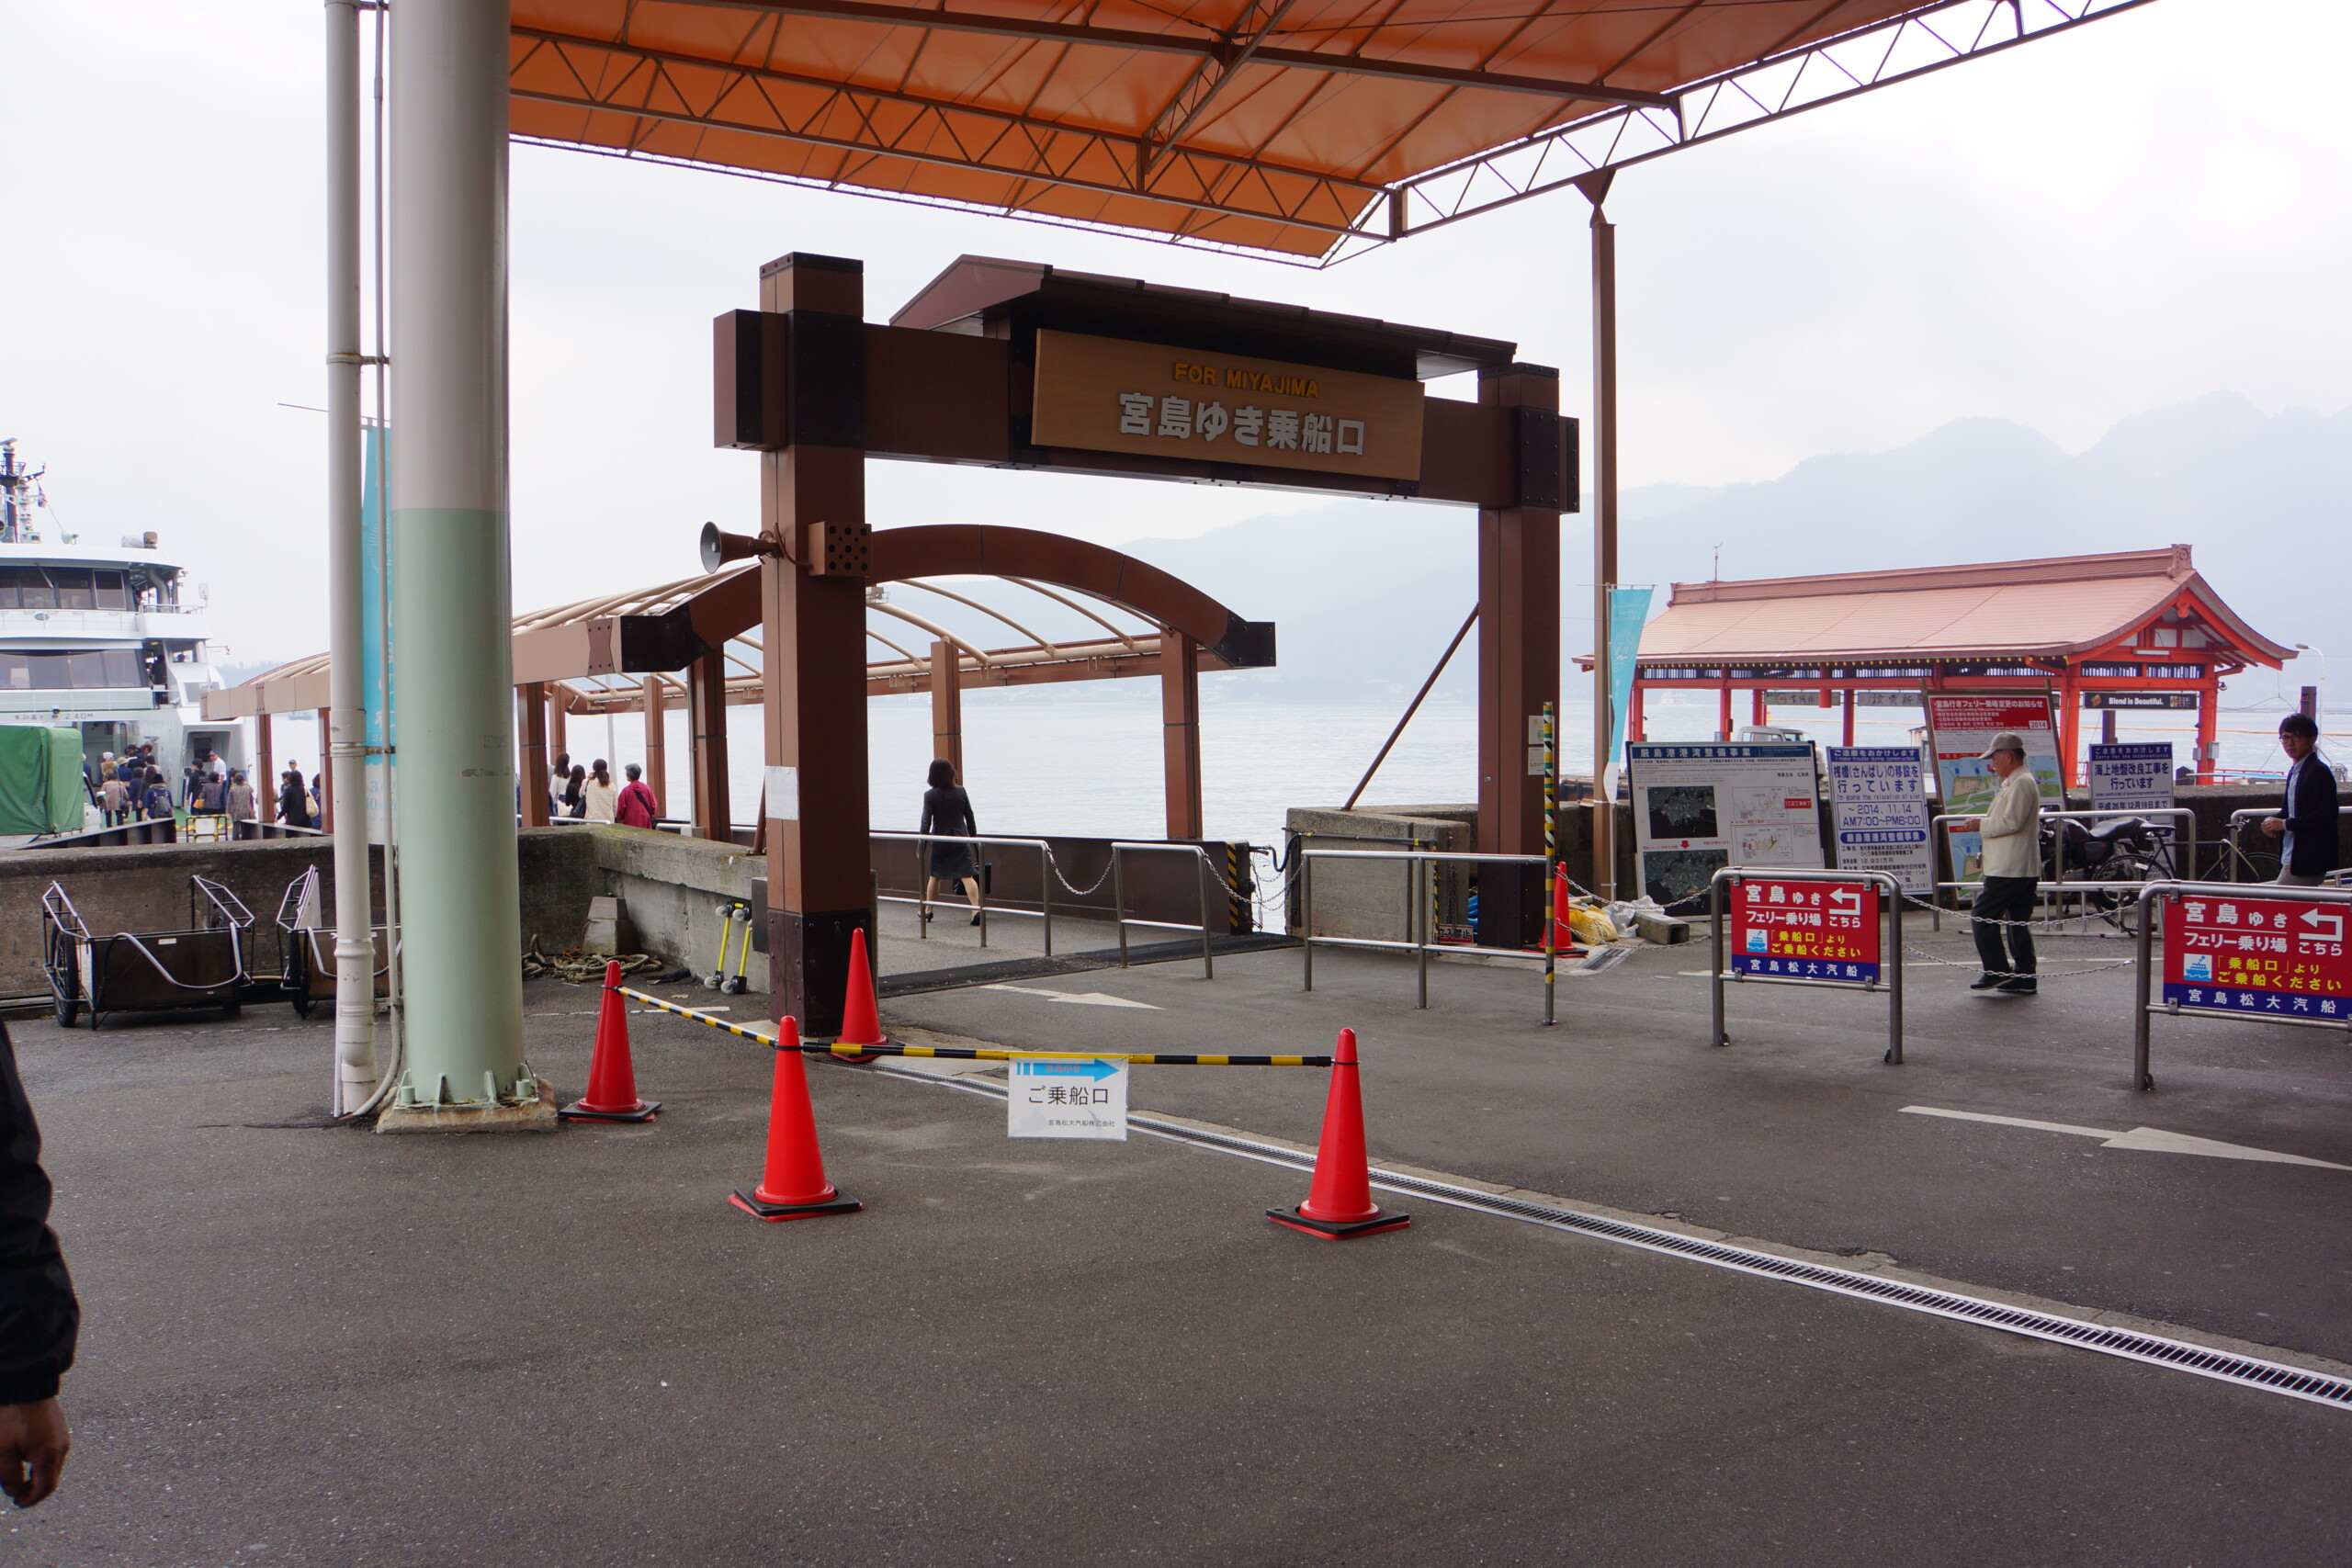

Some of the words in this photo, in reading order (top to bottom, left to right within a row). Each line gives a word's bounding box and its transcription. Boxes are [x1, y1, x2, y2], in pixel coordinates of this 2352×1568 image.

[1174, 363, 1217, 385] FOR
[1227, 369, 1320, 398] MIYAJIMA
[1118, 392, 1365, 455] 宮島ゆき乗船口
[2134, 697, 2164, 705] Beautiful.
[1640, 748, 1751, 758] 厳島港港湾整備事業
[1834, 764, 1918, 778] 桟橋(さんばし)の移設を
[2095, 762, 2169, 776] 海上地盤改良工事を
[1838, 779, 1917, 793] 行っています
[2110, 777, 2154, 790] 行っています
[1889, 804, 1912, 814] 11.14
[1746, 885, 1821, 906] 宮島ゆき
[1746, 910, 1822, 926] フェリー乗り場
[2185, 901, 2288, 929] 宮島ゆき
[1828, 917, 1860, 929] こちら
[1770, 930, 1845, 944] 「乗船口」より
[2184, 931, 2287, 953] フェリー乗り場
[1771, 943, 1861, 957] ご乗船ください
[2299, 942, 2343, 956] こちら
[1750, 959, 1858, 976] 宮島松大汽船
[2217, 955, 2320, 975] 「乗船口」より
[2218, 971, 2342, 991] ご乗船ください
[2188, 988, 2335, 1014] 宮島松大汽船
[1045, 1064, 1081, 1073] 宮島ゆき
[1028, 1085, 1109, 1106] ご乗船口
[1048, 1119, 1115, 1127] 宮島松大汽船株式会社
